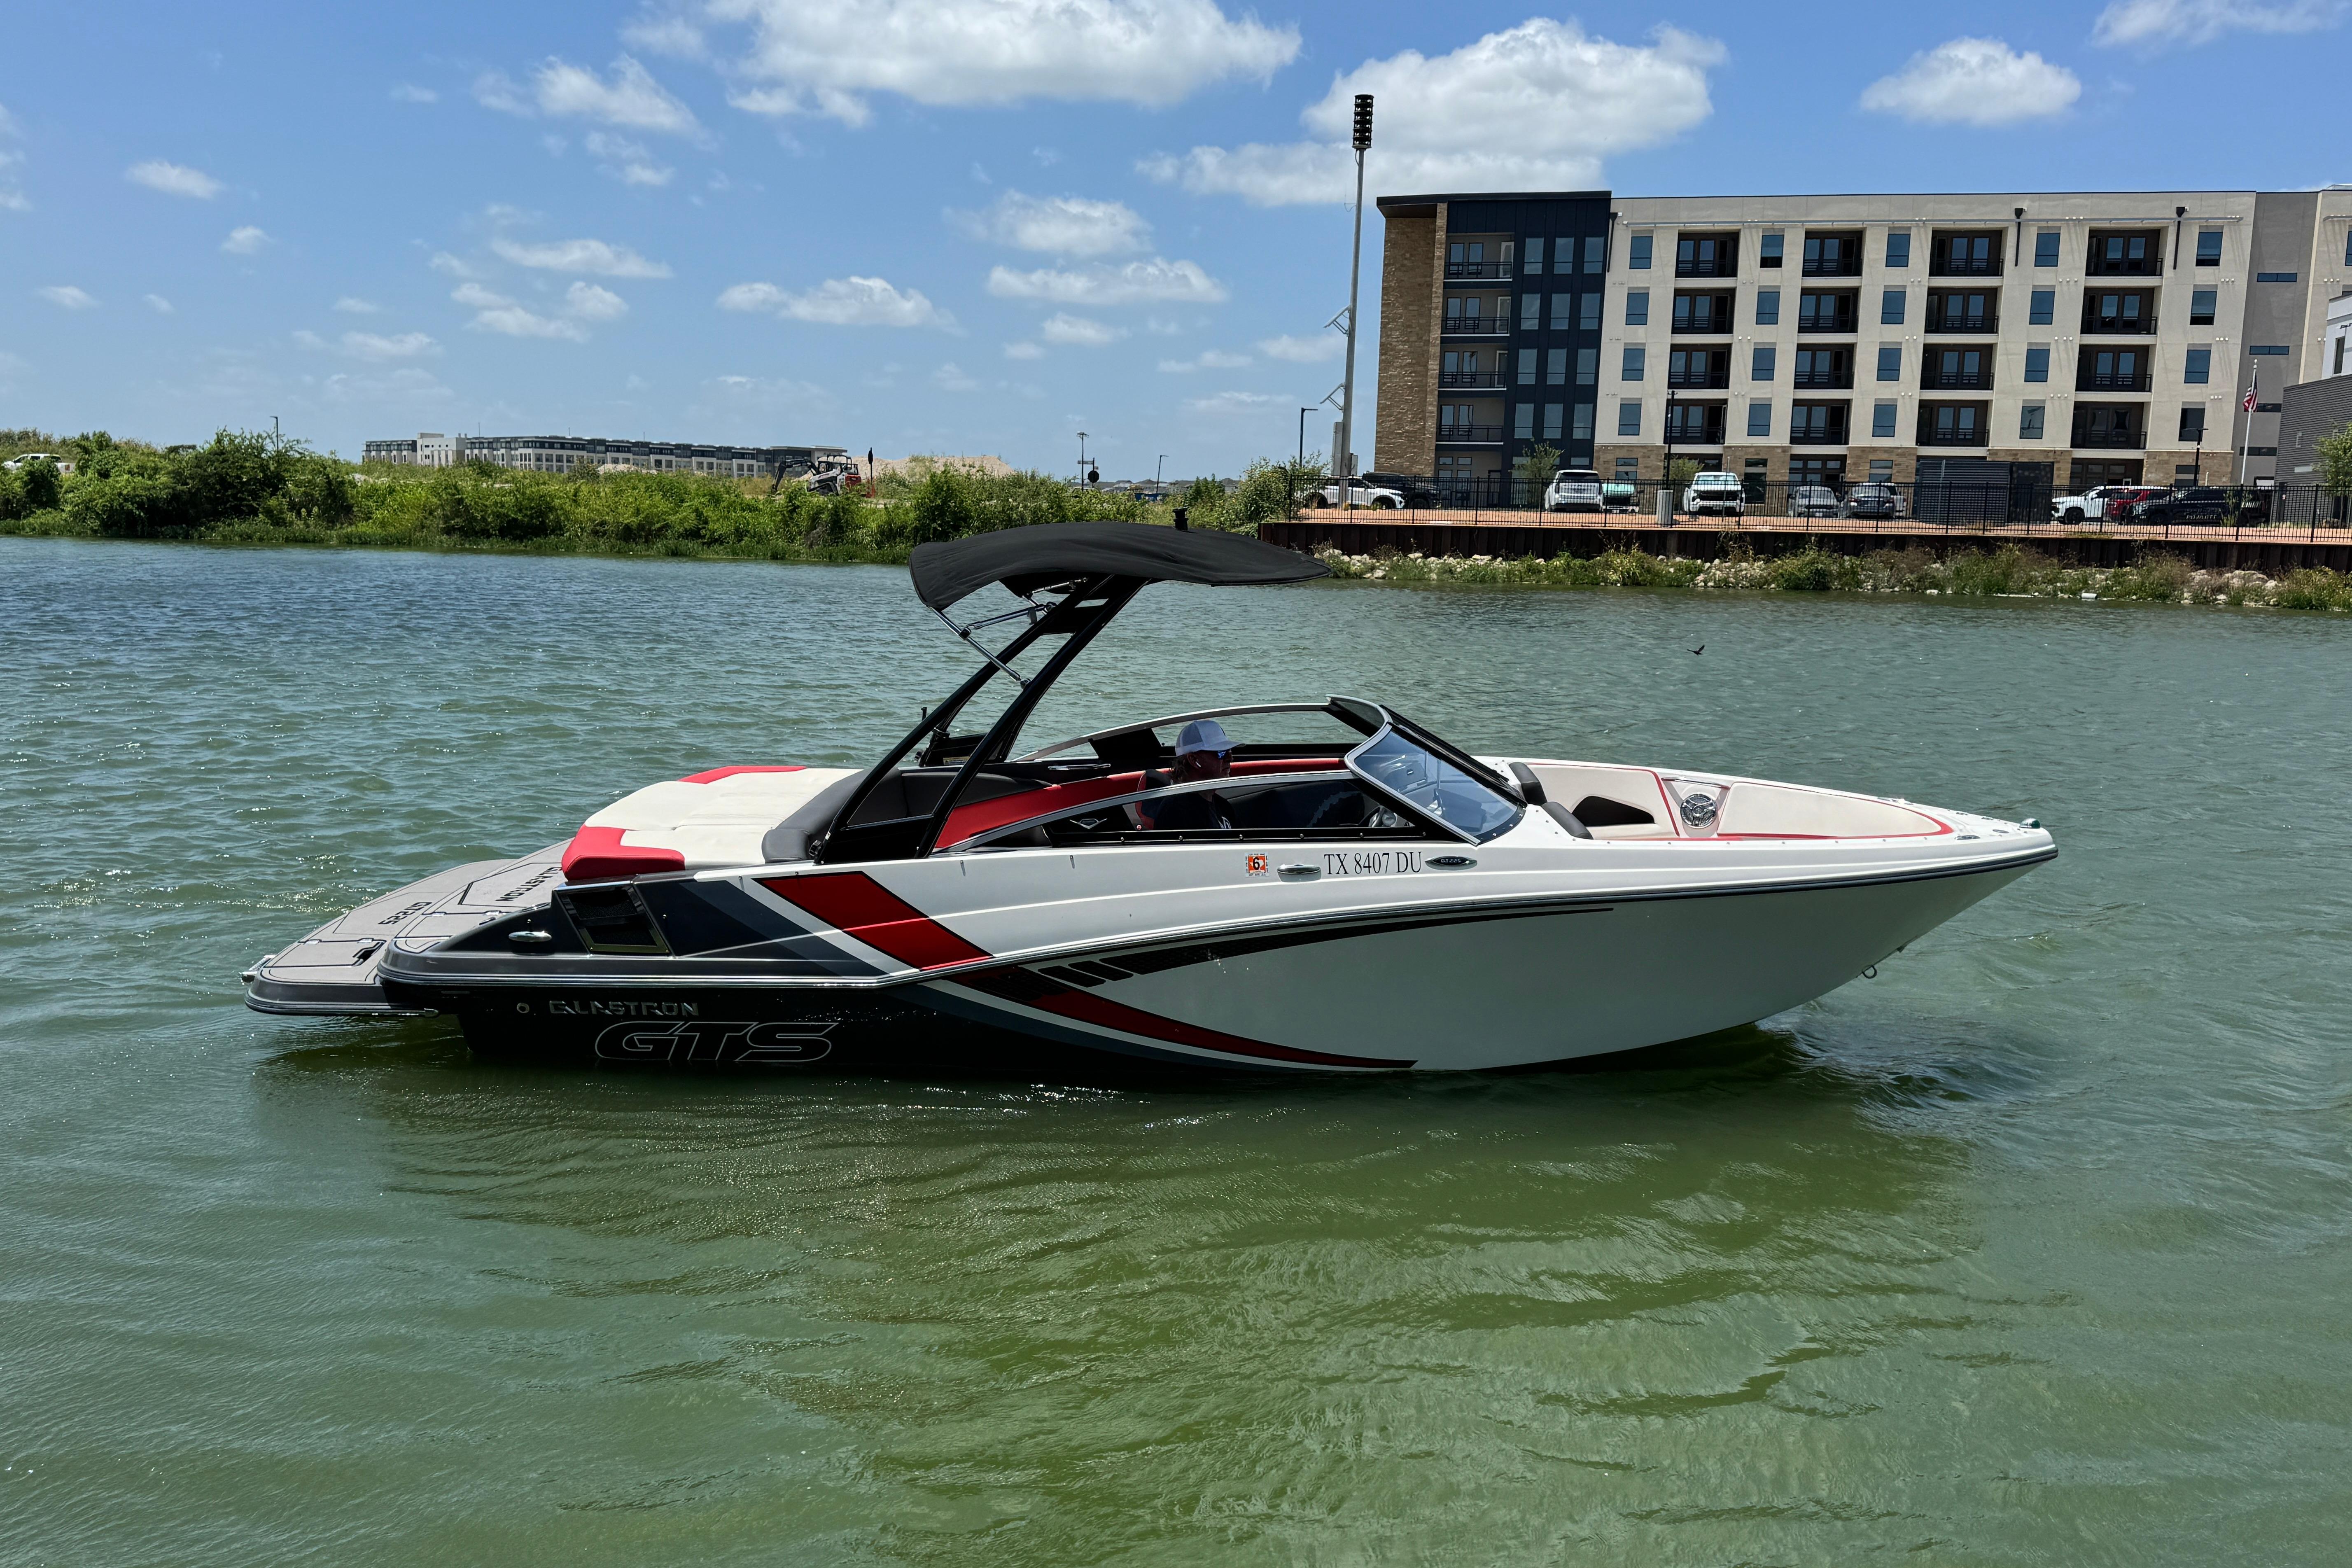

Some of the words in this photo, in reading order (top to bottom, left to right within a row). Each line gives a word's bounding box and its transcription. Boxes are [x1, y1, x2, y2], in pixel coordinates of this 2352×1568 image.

[1253, 856, 1260, 870] 6
[1323, 853, 1349, 875] TX
[1354, 852, 1390, 874] 8407
[1395, 851, 1423, 873] DU
[495, 867, 562, 901] GLASTRON
[378, 902, 432, 924] GT225
[549, 1000, 699, 1017] GLASTRON
[595, 1021, 839, 1062] GTS
